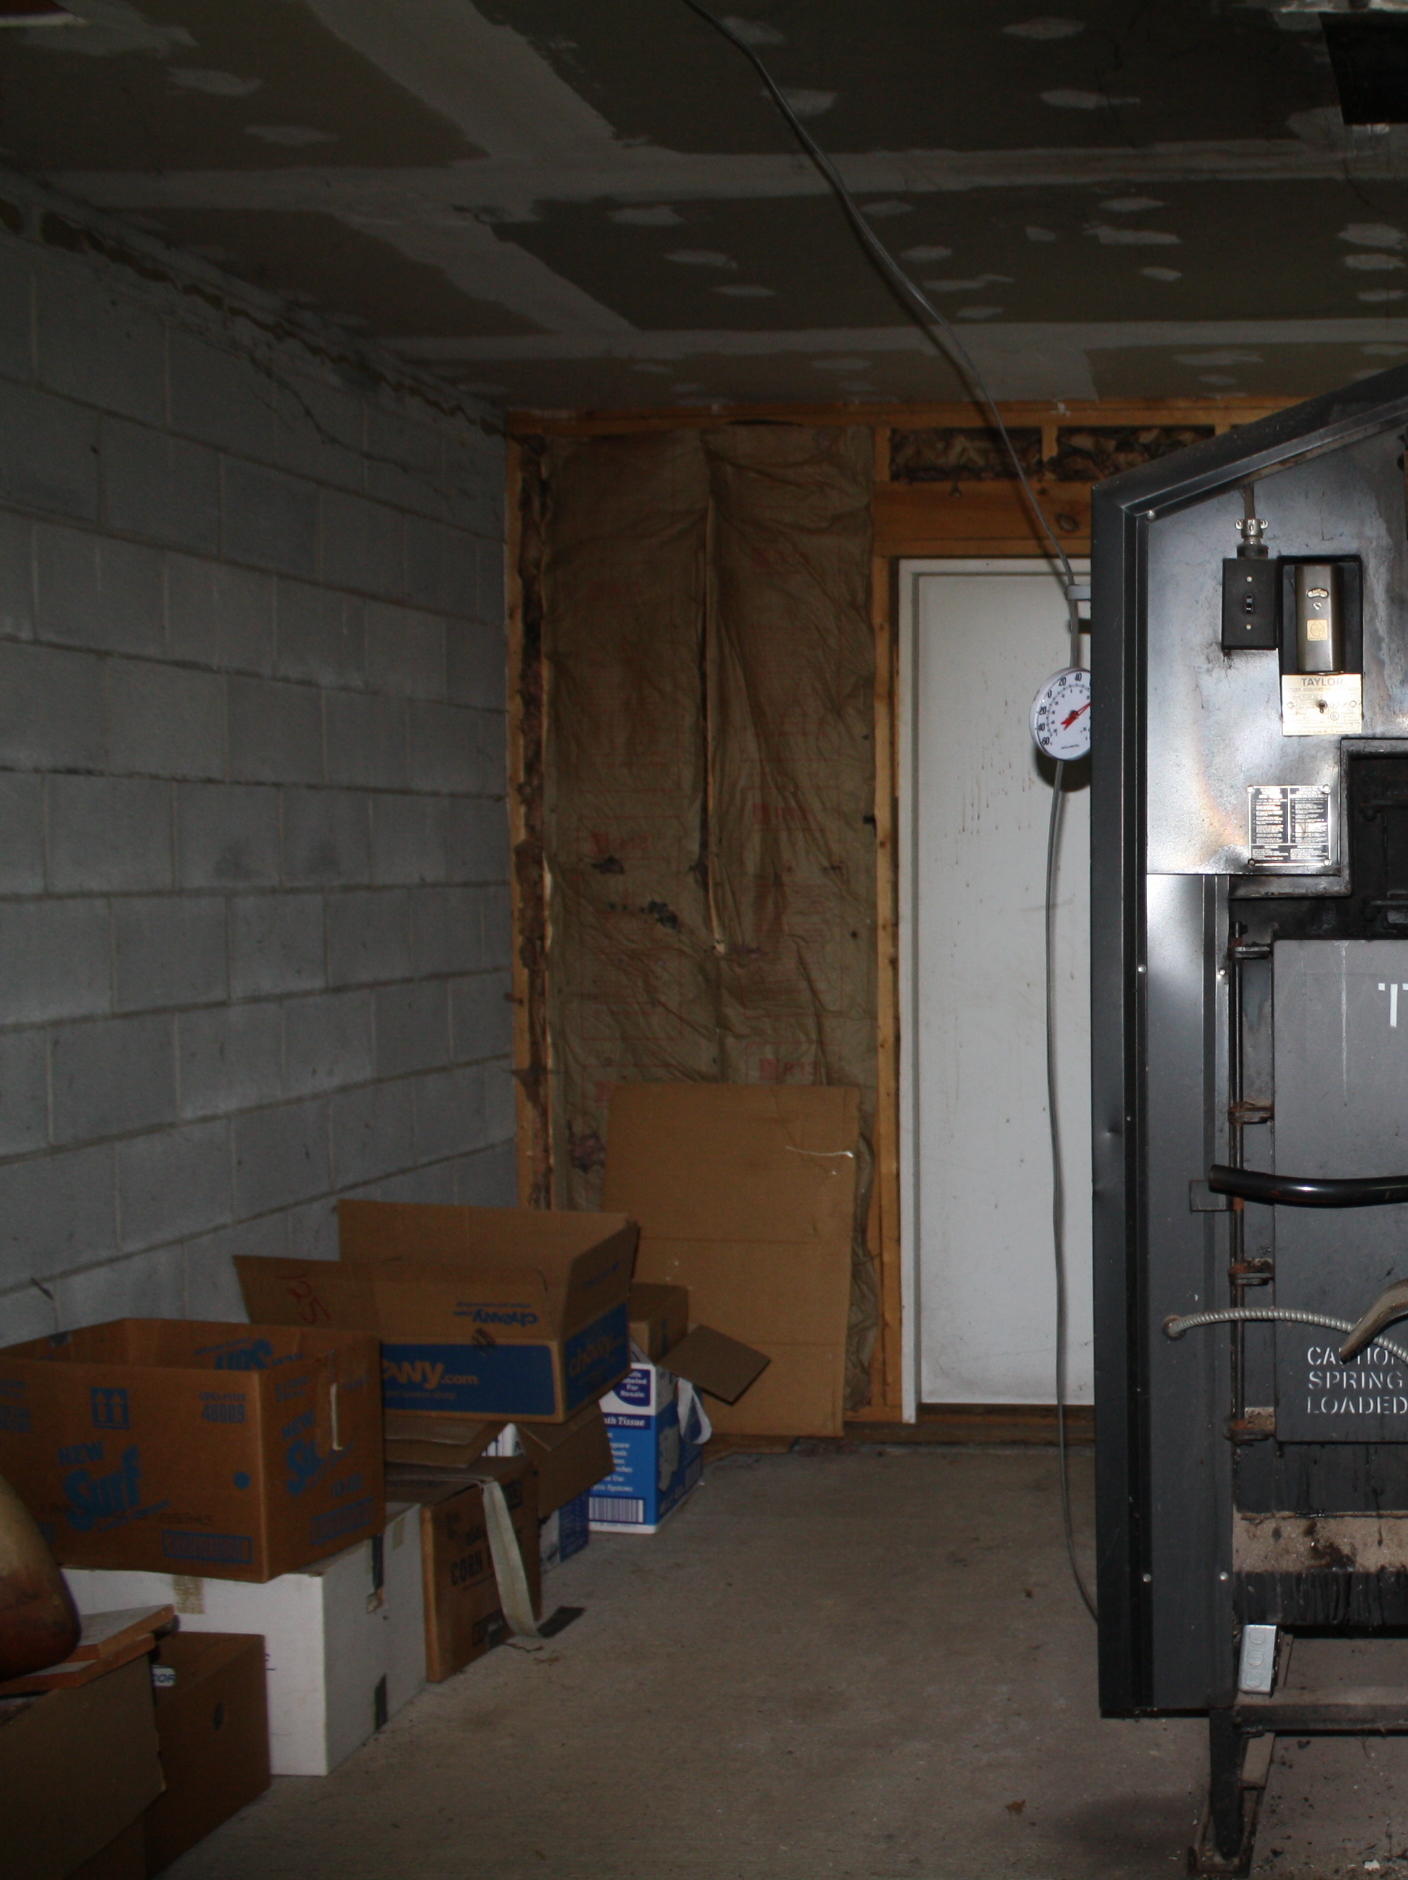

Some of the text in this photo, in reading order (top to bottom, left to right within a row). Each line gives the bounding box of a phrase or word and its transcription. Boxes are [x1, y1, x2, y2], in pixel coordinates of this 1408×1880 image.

[1059, 677, 1067, 686] 20
[1047, 690, 1052, 698] 0
[1307, 1347, 1395, 1365] CAIO
[1308, 1371, 1403, 1389] SPRING
[1306, 1396, 1408, 1414] LOADED
